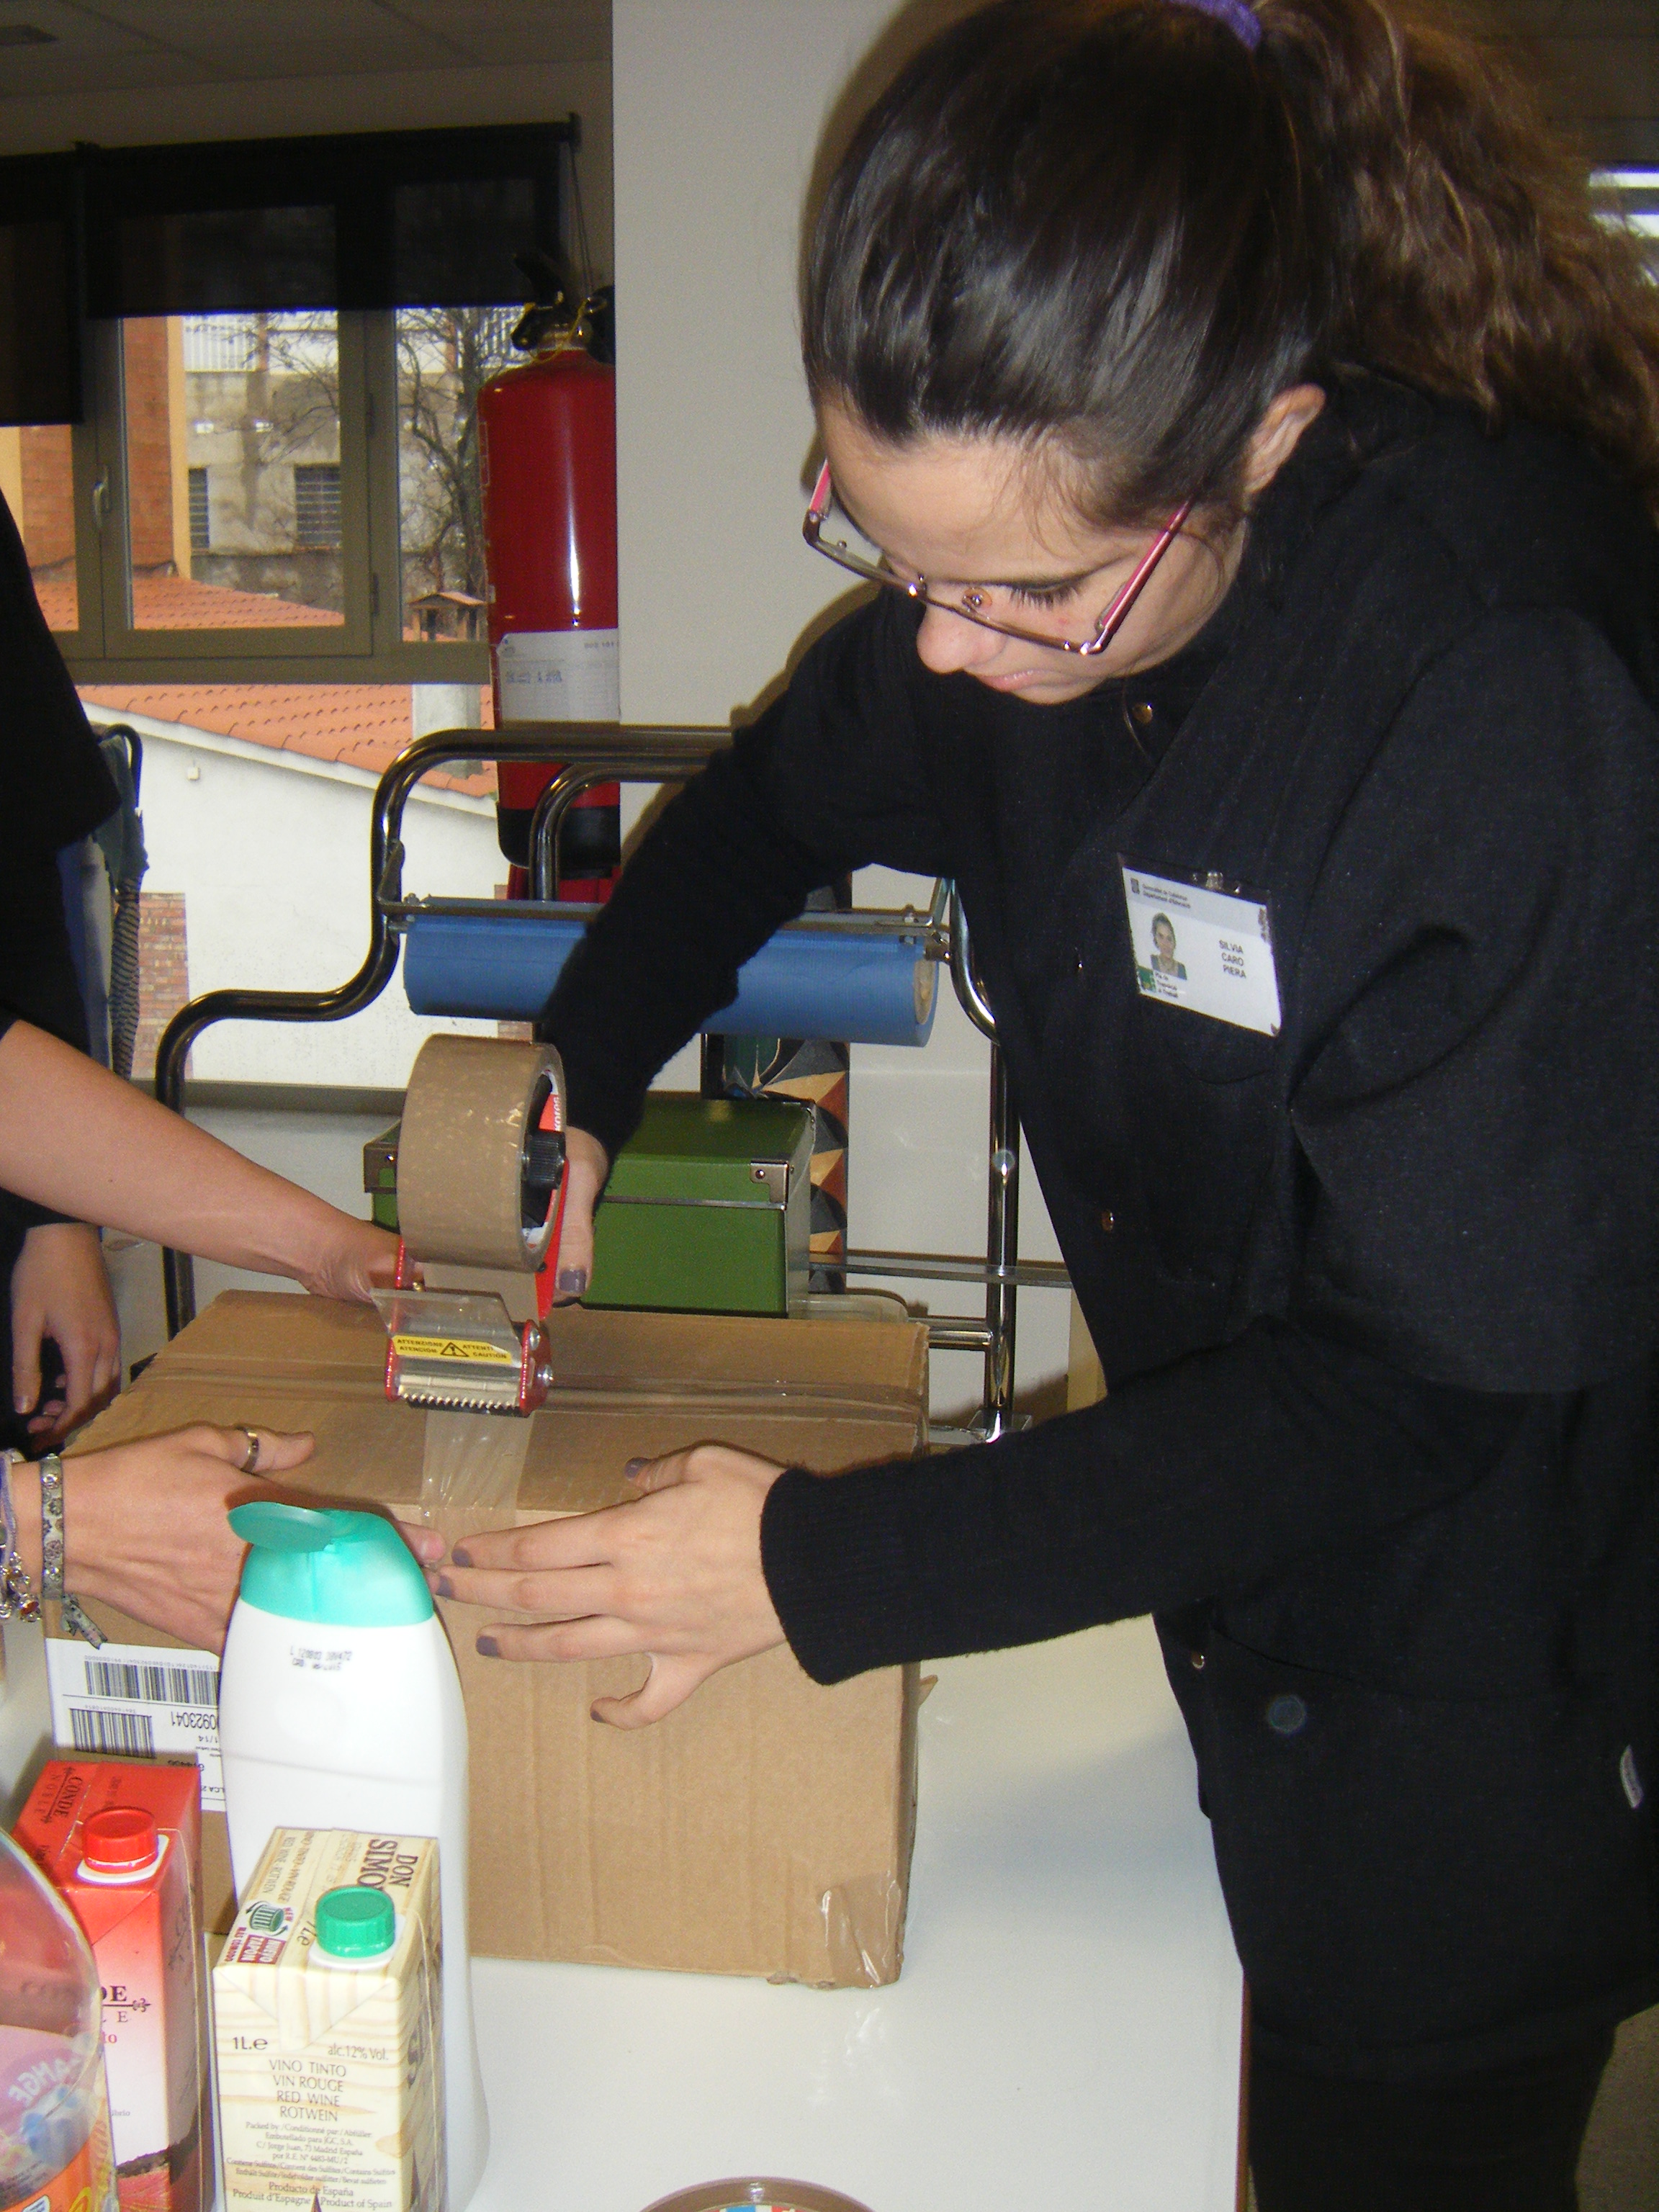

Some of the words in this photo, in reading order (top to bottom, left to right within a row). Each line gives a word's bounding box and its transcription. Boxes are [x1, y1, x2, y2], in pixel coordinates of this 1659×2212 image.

[1219, 940, 1244, 954] SILVIA
[1221, 952, 1244, 966] CARO
[1223, 964, 1246, 979] PIERA
[54, 1776, 83, 1817] CONDE
[357, 1838, 398, 1890] SIMO
[389, 1853, 419, 1888] DON
[259, 1939, 282, 1963] NUEVO
[269, 2059, 302, 2072] VINO
[309, 2062, 346, 2077] TINTO
[273, 2074, 295, 2087] VIN
[300, 2077, 343, 2092] ROUGE
[276, 2090, 301, 2103] RED
[307, 2092, 340, 2107] WINE
[280, 2105, 338, 2122] ROTWEIN
[269, 2181, 308, 2193] Producto
[323, 2185, 354, 2198] España
[233, 2188, 264, 2200] Produit
[266, 2192, 312, 2207] d'Espagne
[320, 2196, 355, 2208] Product
[356, 2199, 366, 2208] of
[367, 2199, 392, 2211] Spain
